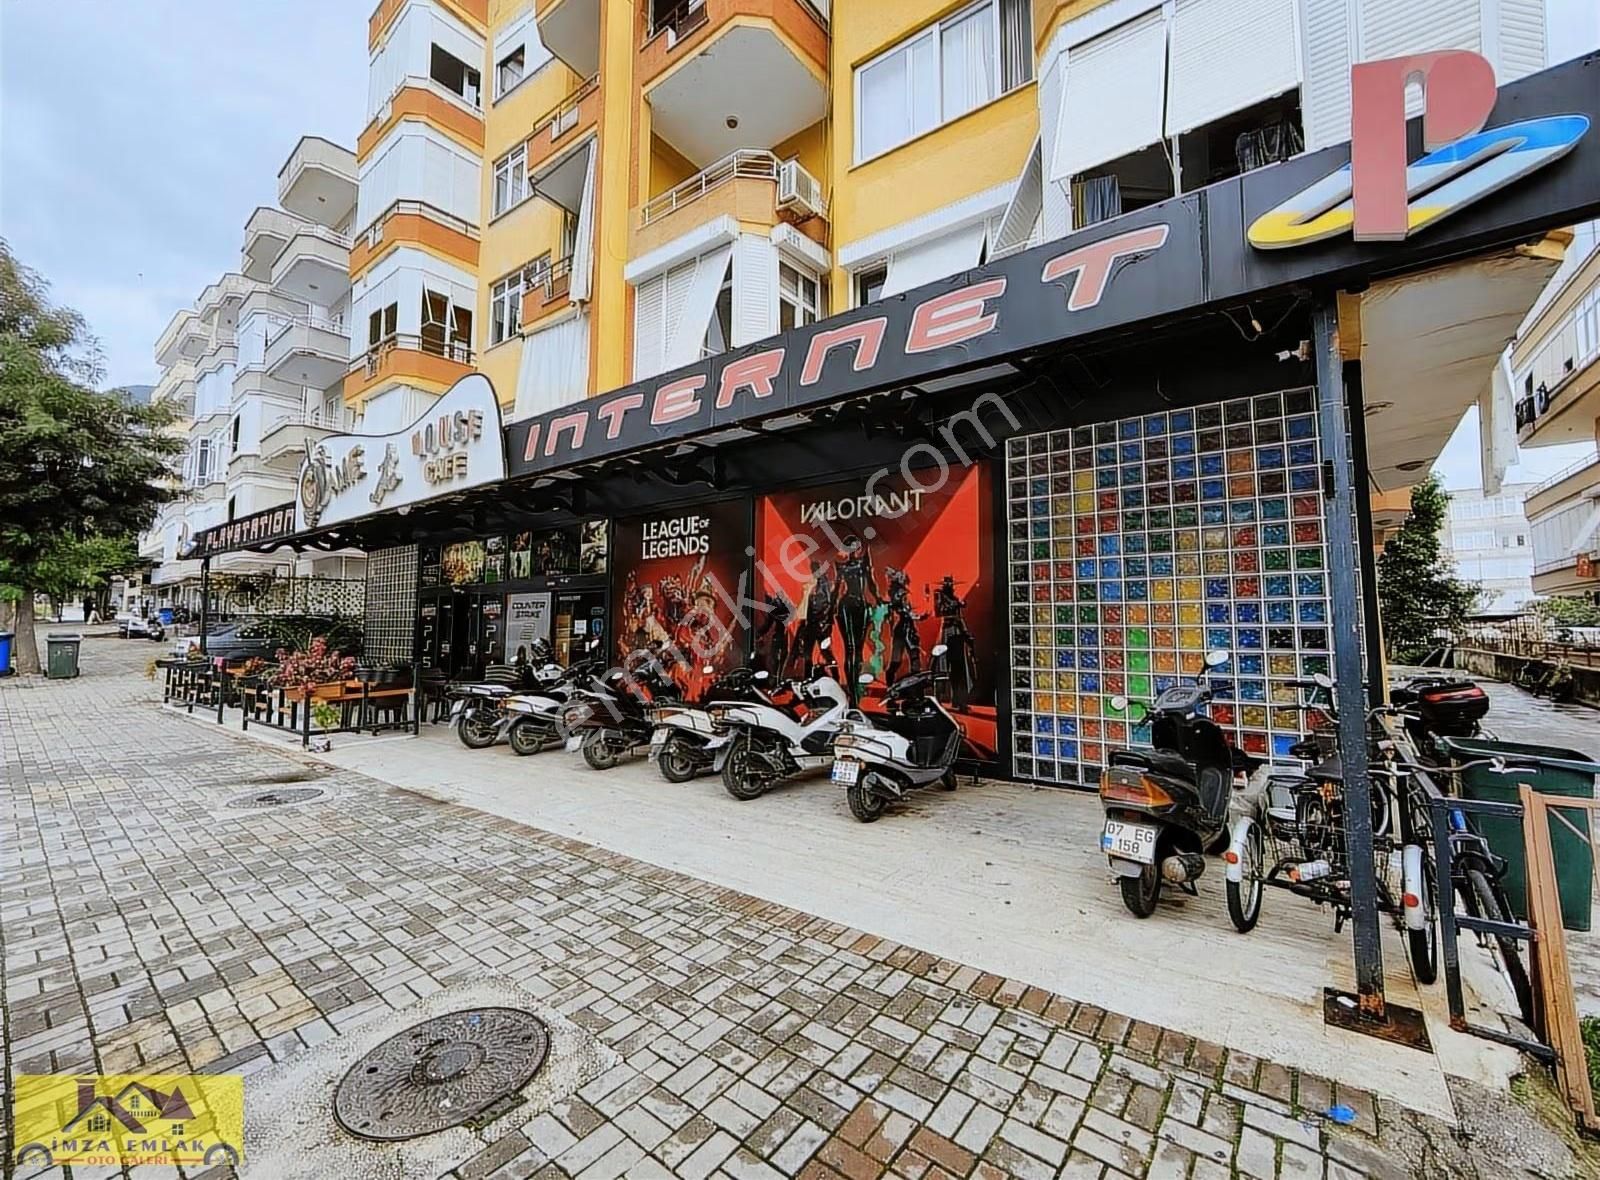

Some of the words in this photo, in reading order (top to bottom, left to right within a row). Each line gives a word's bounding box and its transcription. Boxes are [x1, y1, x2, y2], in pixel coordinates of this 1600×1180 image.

[524, 223, 1170, 462] INTERNET
[424, 451, 468, 486] CAFE
[800, 489, 926, 524] VALORANT
[205, 508, 295, 552] PLAYSTATION
[643, 515, 699, 541] LEAGUE
[699, 518, 710, 530] OF
[642, 535, 709, 560] LEGENDS
[512, 601, 546, 610] COUNTER
[1107, 822, 1125, 836] 07
[1135, 828, 1154, 843] EG
[1118, 838, 1140, 854] 158
